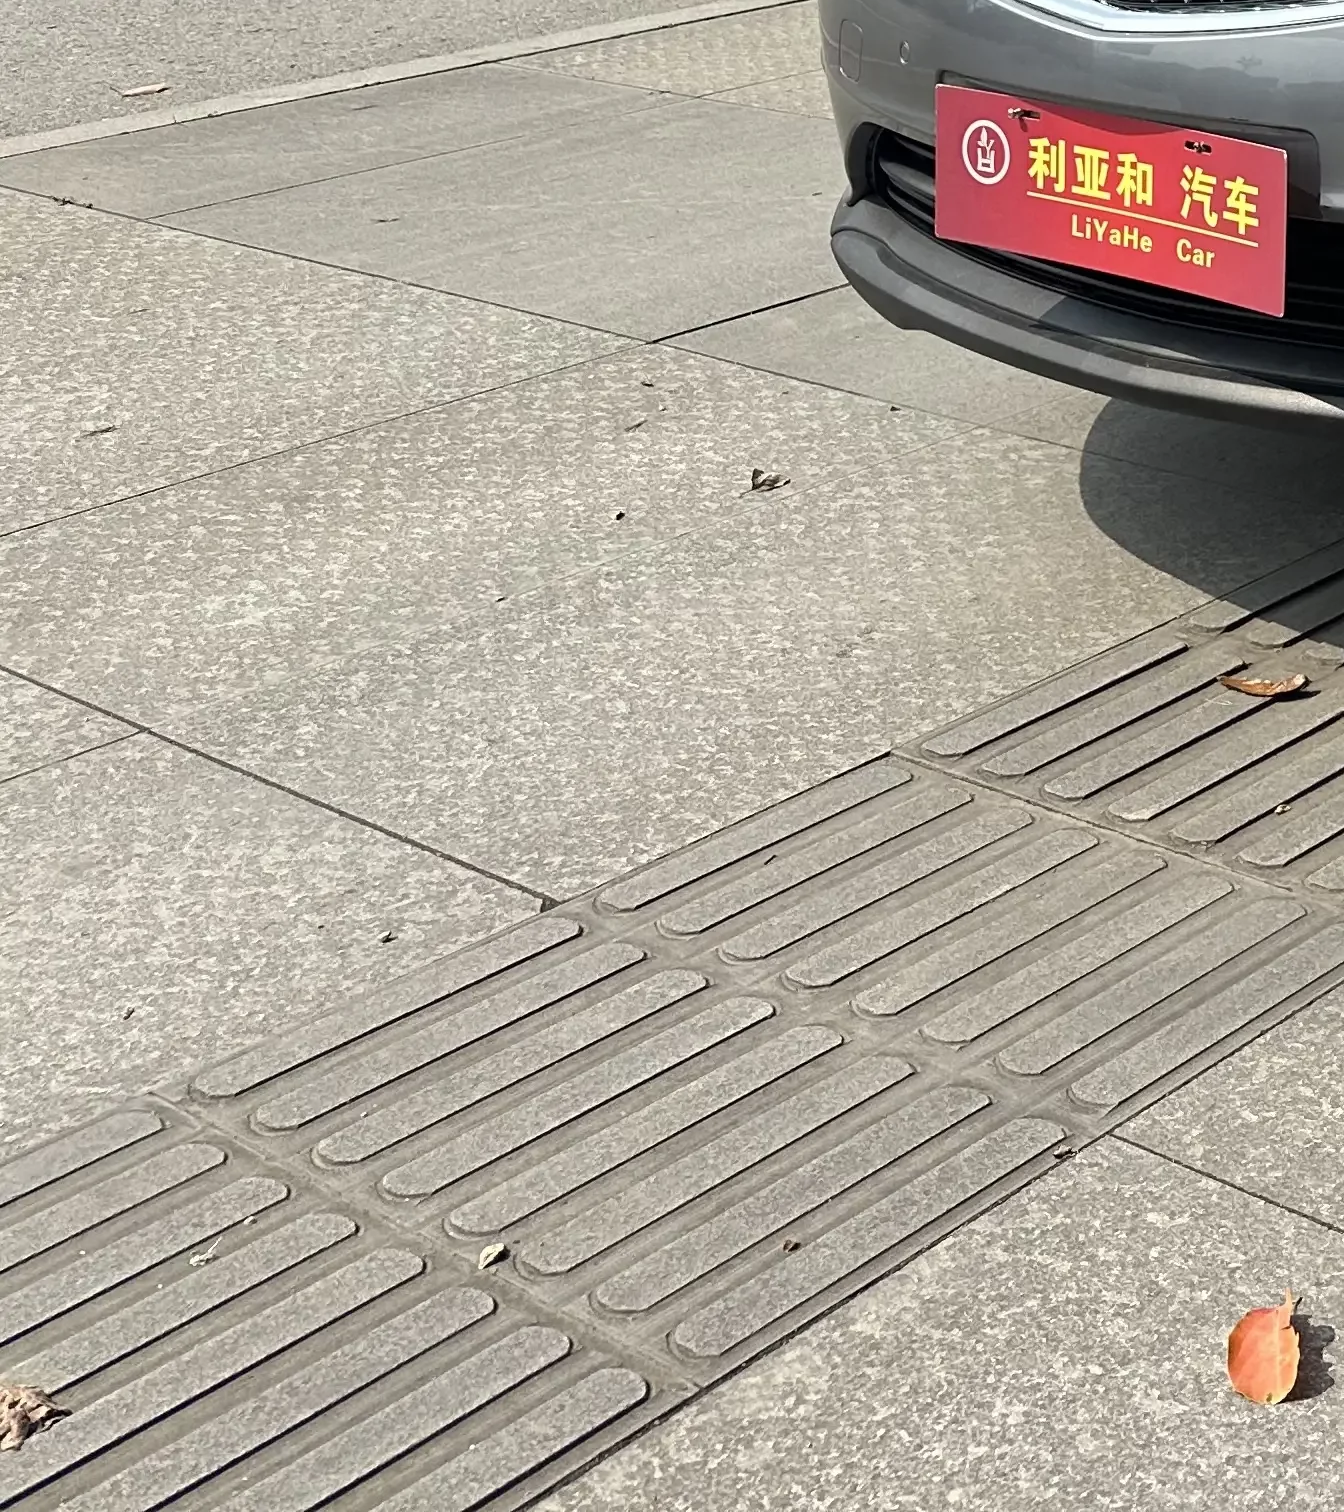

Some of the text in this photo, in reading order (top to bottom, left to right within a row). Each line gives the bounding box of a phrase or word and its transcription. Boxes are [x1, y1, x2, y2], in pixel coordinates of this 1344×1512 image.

[1027, 137, 1259, 235] 利亚和 汽车
[1071, 213, 1216, 268] LiYaHe Car
